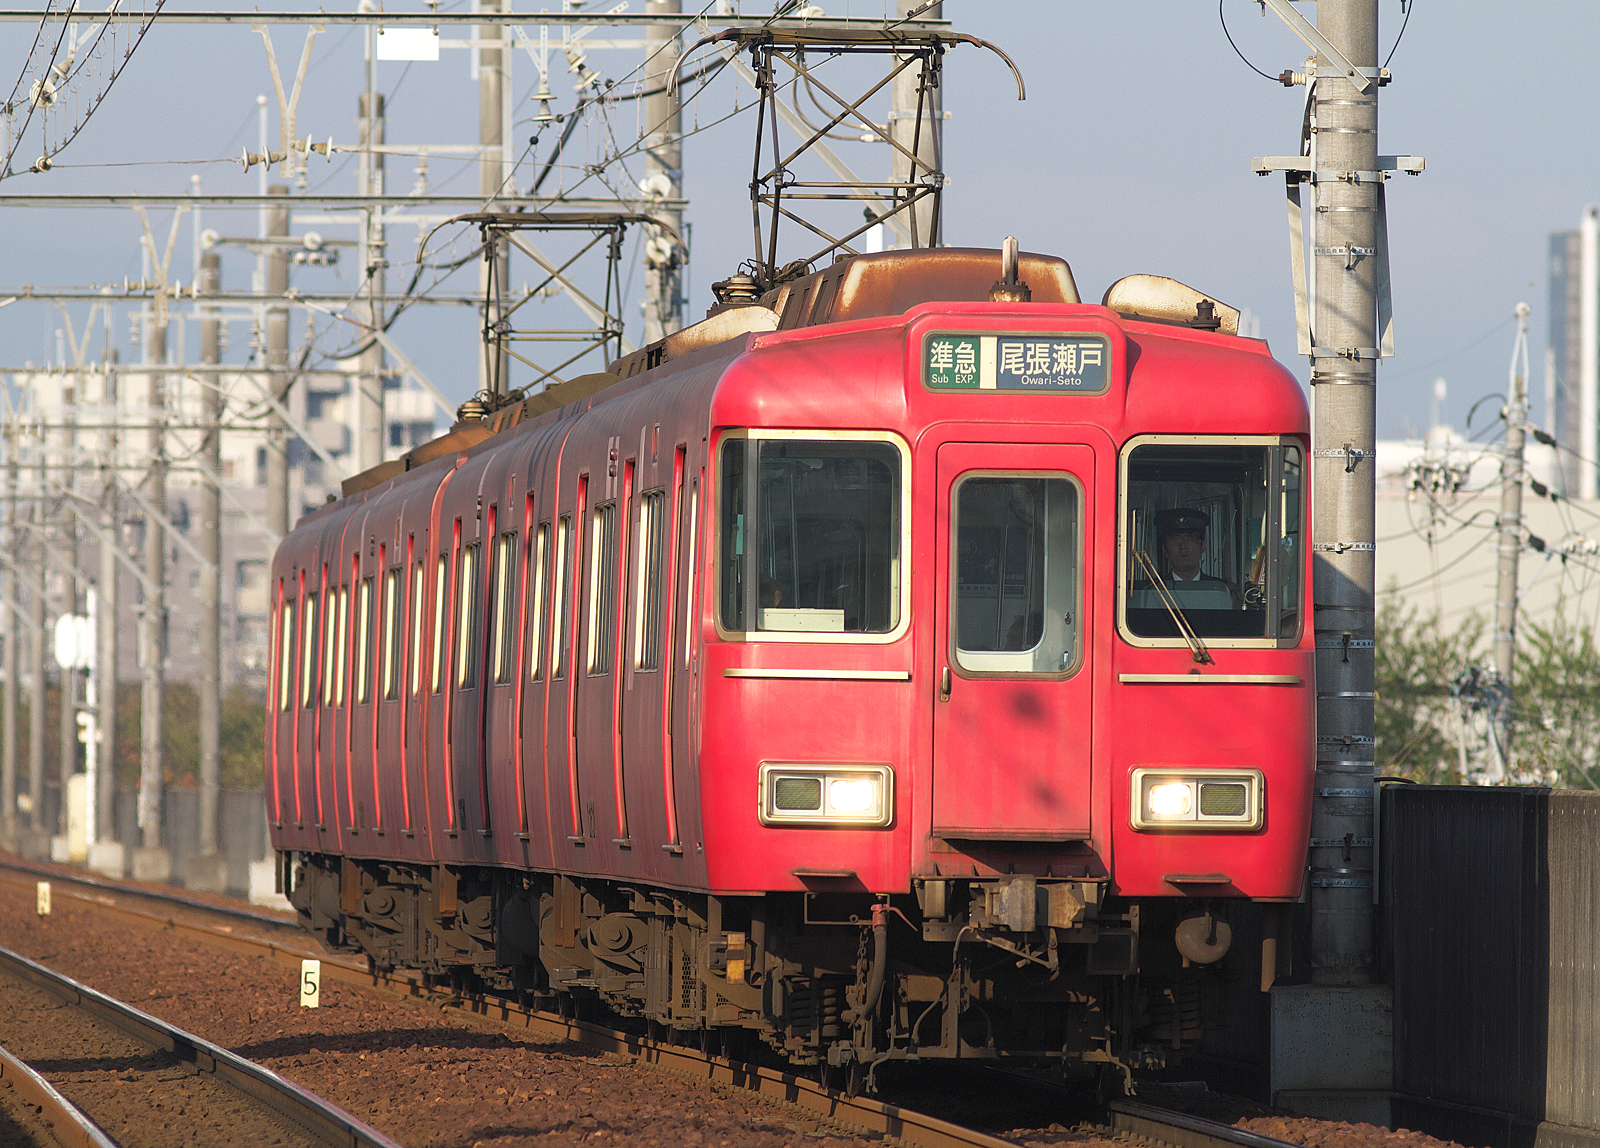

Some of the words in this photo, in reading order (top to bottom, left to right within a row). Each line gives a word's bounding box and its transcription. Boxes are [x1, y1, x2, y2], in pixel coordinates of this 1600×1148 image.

[930, 341, 977, 375] 準急
[999, 342, 1104, 376] 尾張瀬戸
[931, 374, 949, 383] Sub
[955, 375, 976, 384] EXP.
[1021, 375, 1082, 386] Owari-Seto
[303, 971, 317, 996] 5
